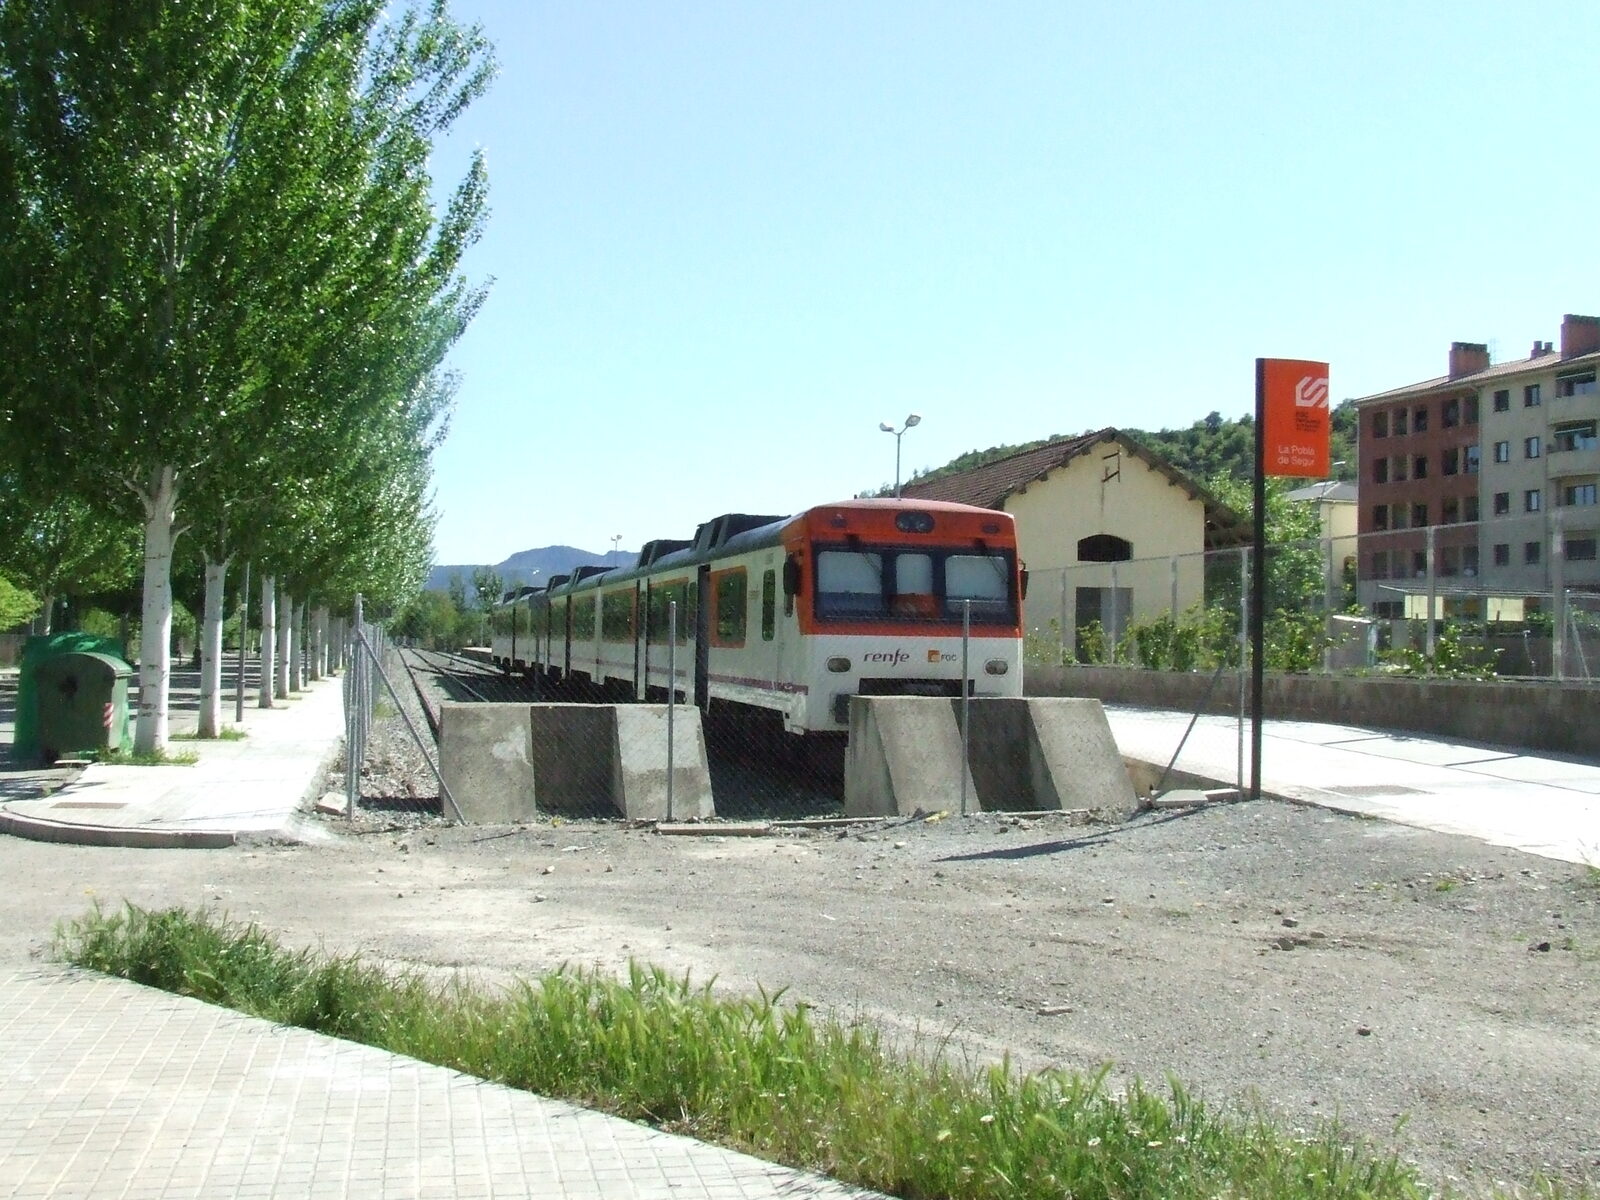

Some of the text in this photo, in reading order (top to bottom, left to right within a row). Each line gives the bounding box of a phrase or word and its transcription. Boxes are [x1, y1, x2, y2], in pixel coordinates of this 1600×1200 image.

[1278, 444, 1315, 456] La Pobla
[1277, 455, 1315, 467] de Segur
[863, 648, 910, 668] renfe
